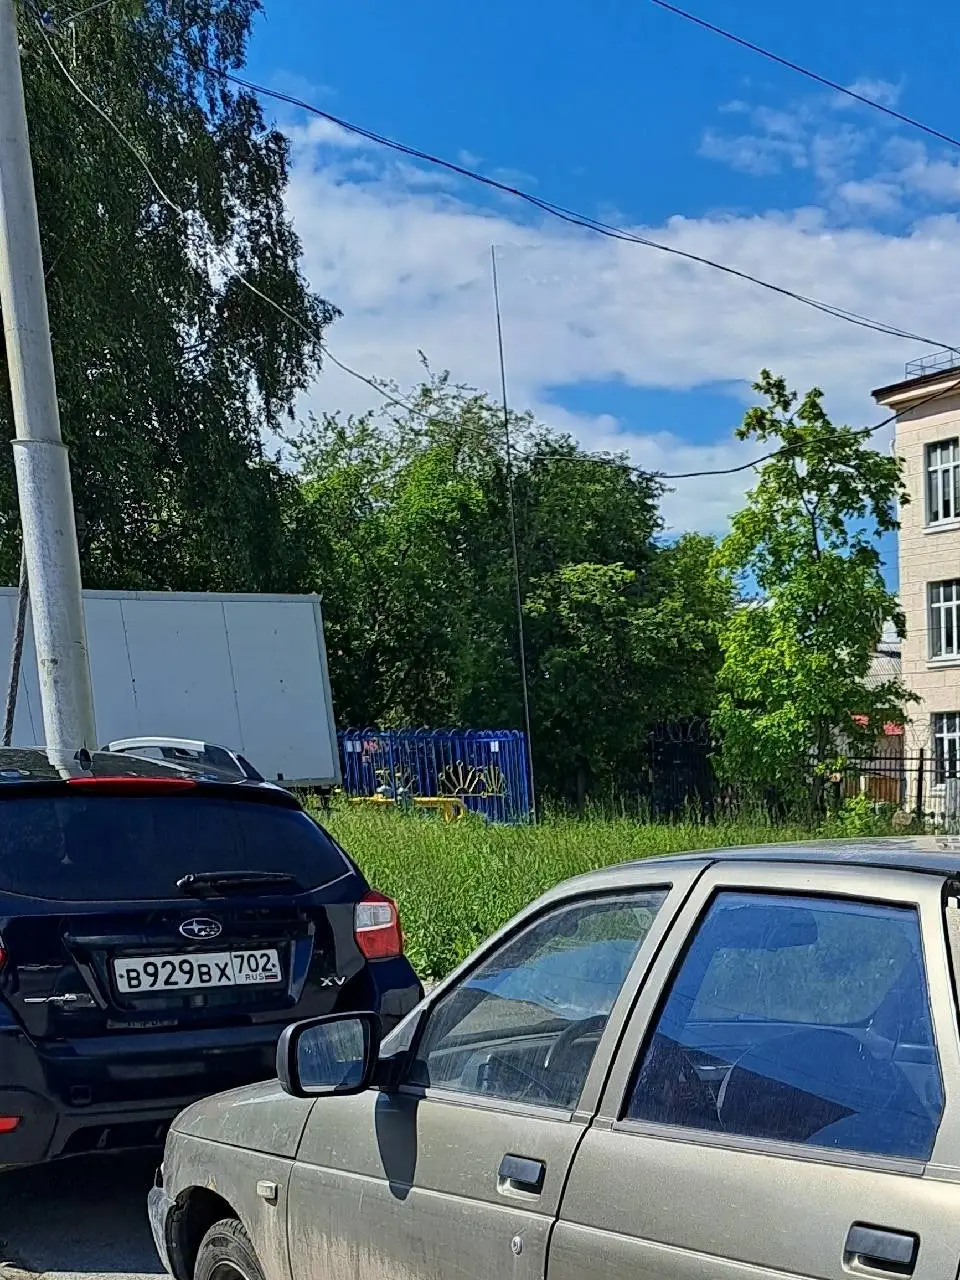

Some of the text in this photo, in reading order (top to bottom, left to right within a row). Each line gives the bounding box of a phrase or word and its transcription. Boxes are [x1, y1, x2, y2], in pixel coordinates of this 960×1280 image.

[126, 953, 273, 989] В929ВХ 702
[245, 974, 265, 982] RUS
[320, 976, 346, 987] XV
